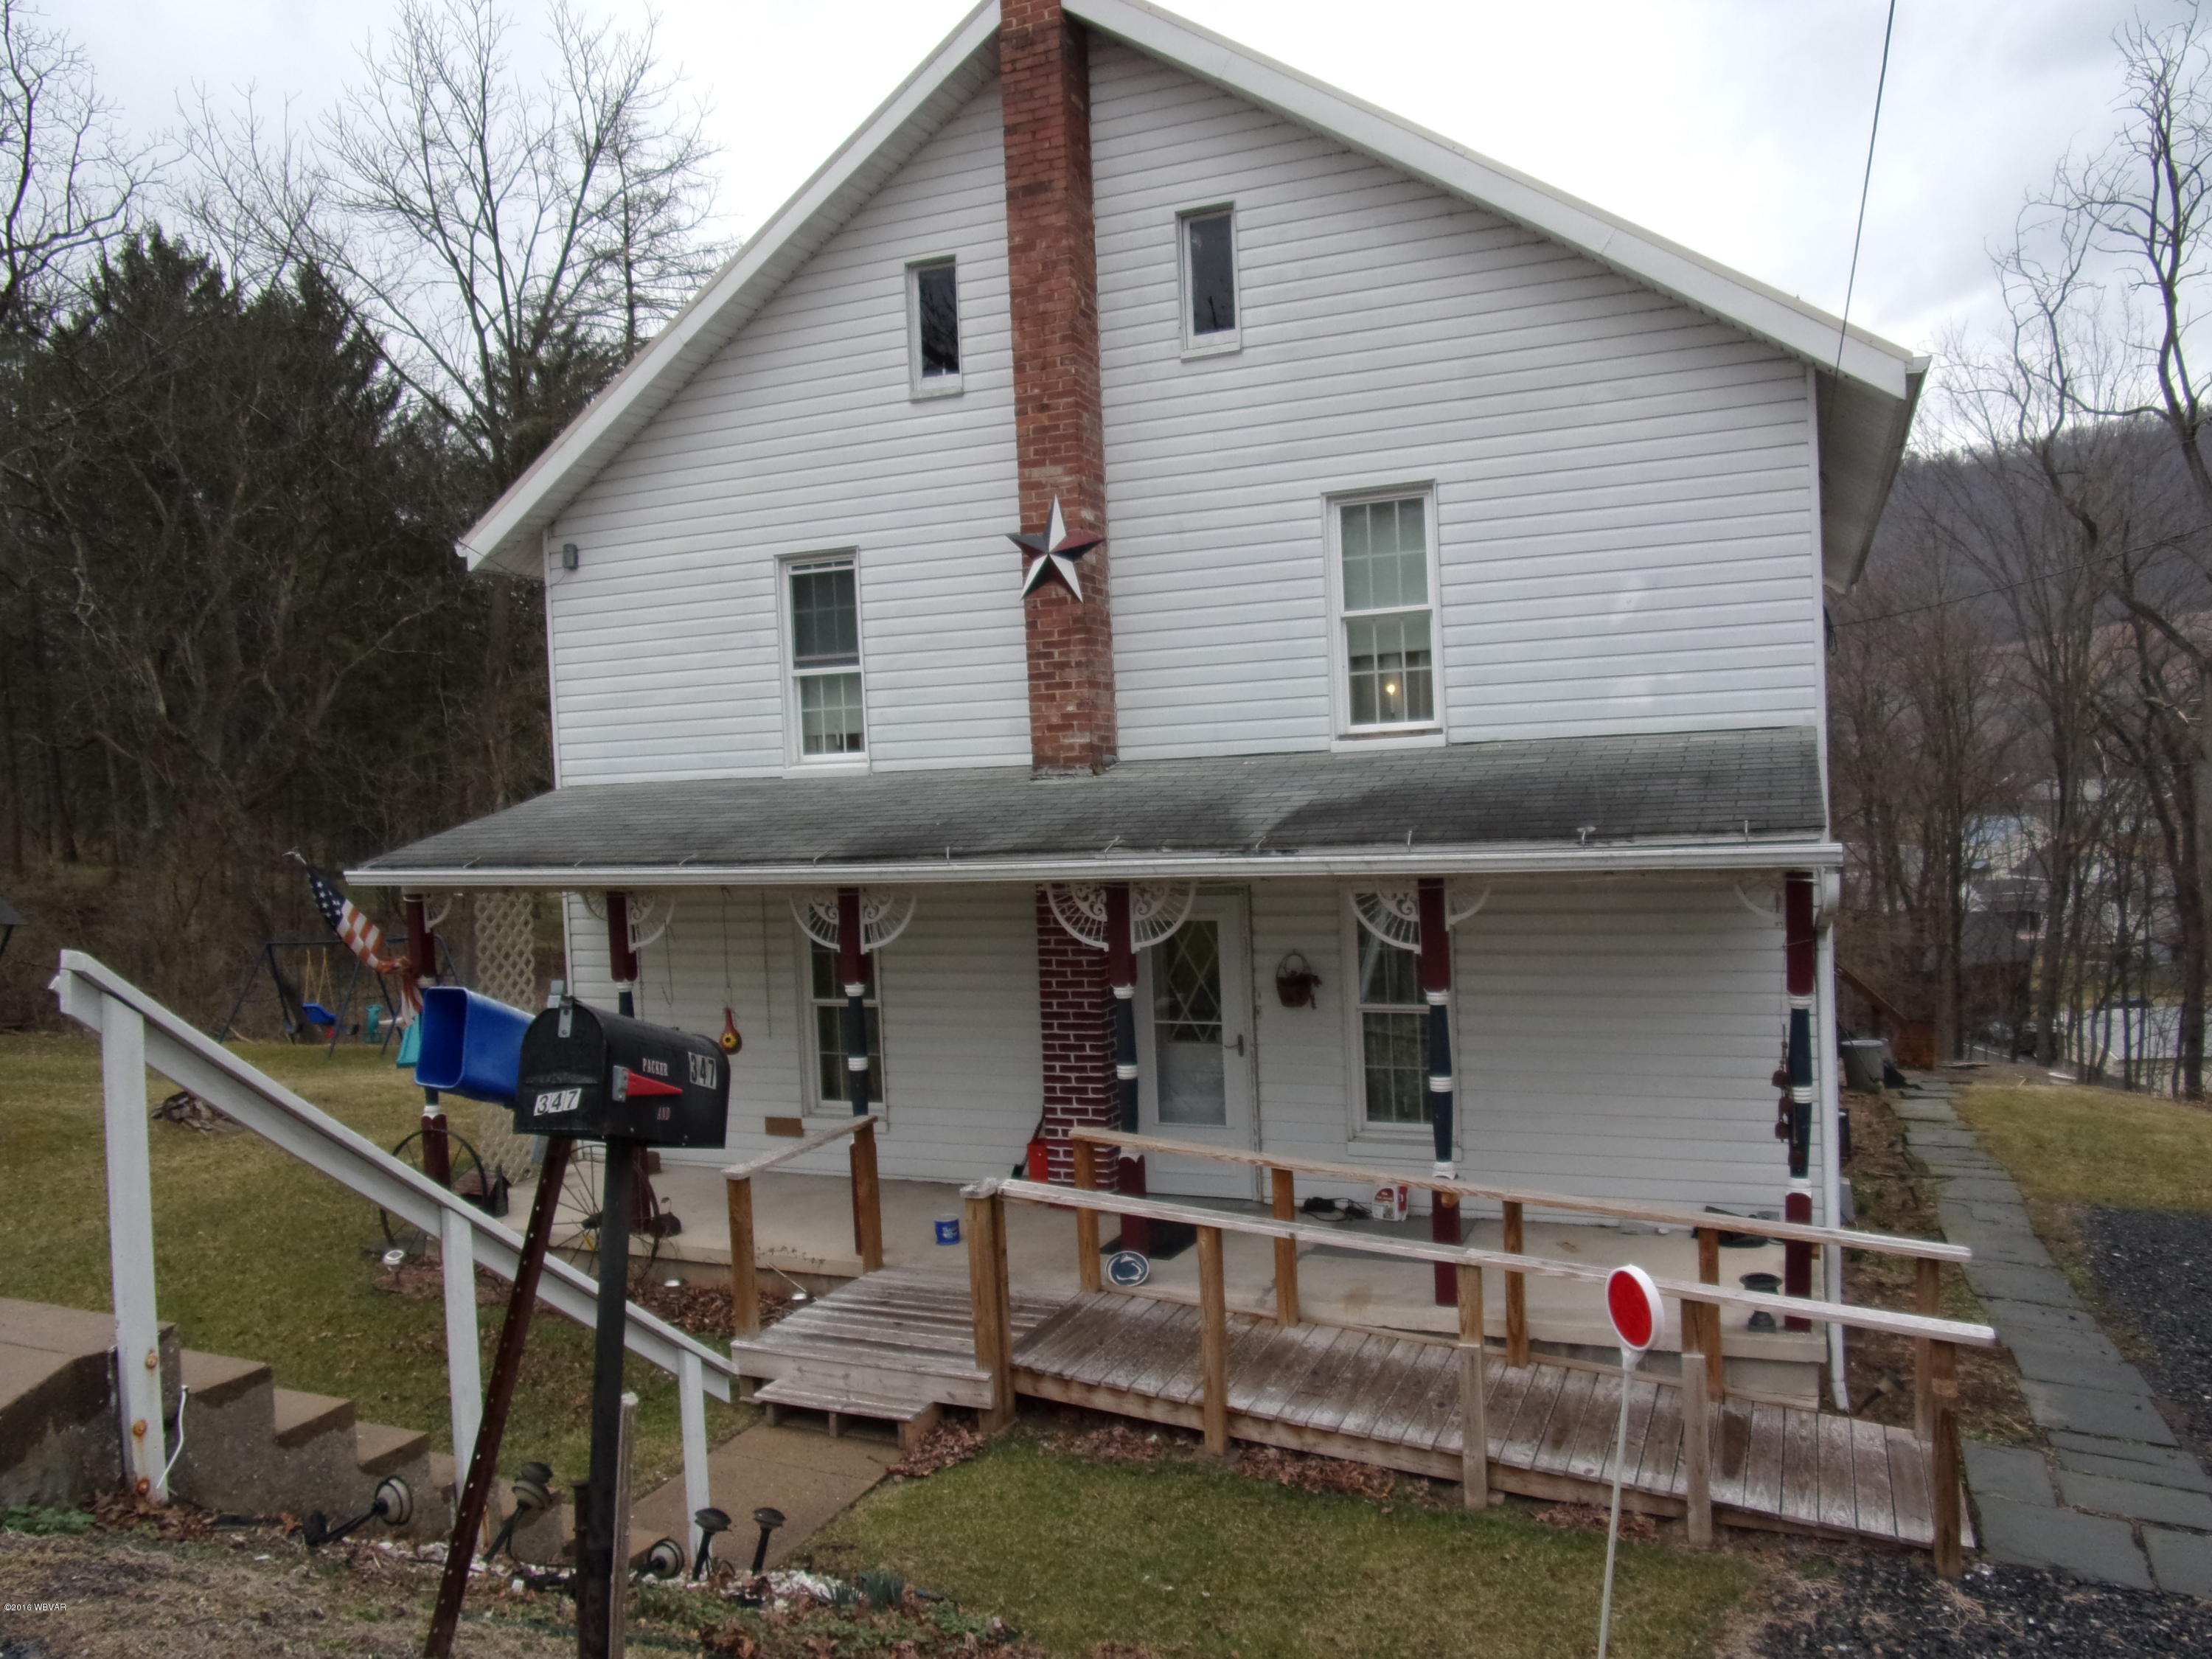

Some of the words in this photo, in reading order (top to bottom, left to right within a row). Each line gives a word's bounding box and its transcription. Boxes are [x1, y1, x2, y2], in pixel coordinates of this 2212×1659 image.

[642, 1057, 669, 1077] PACKER
[689, 1054, 714, 1087] 347
[536, 1090, 579, 1114] 347
